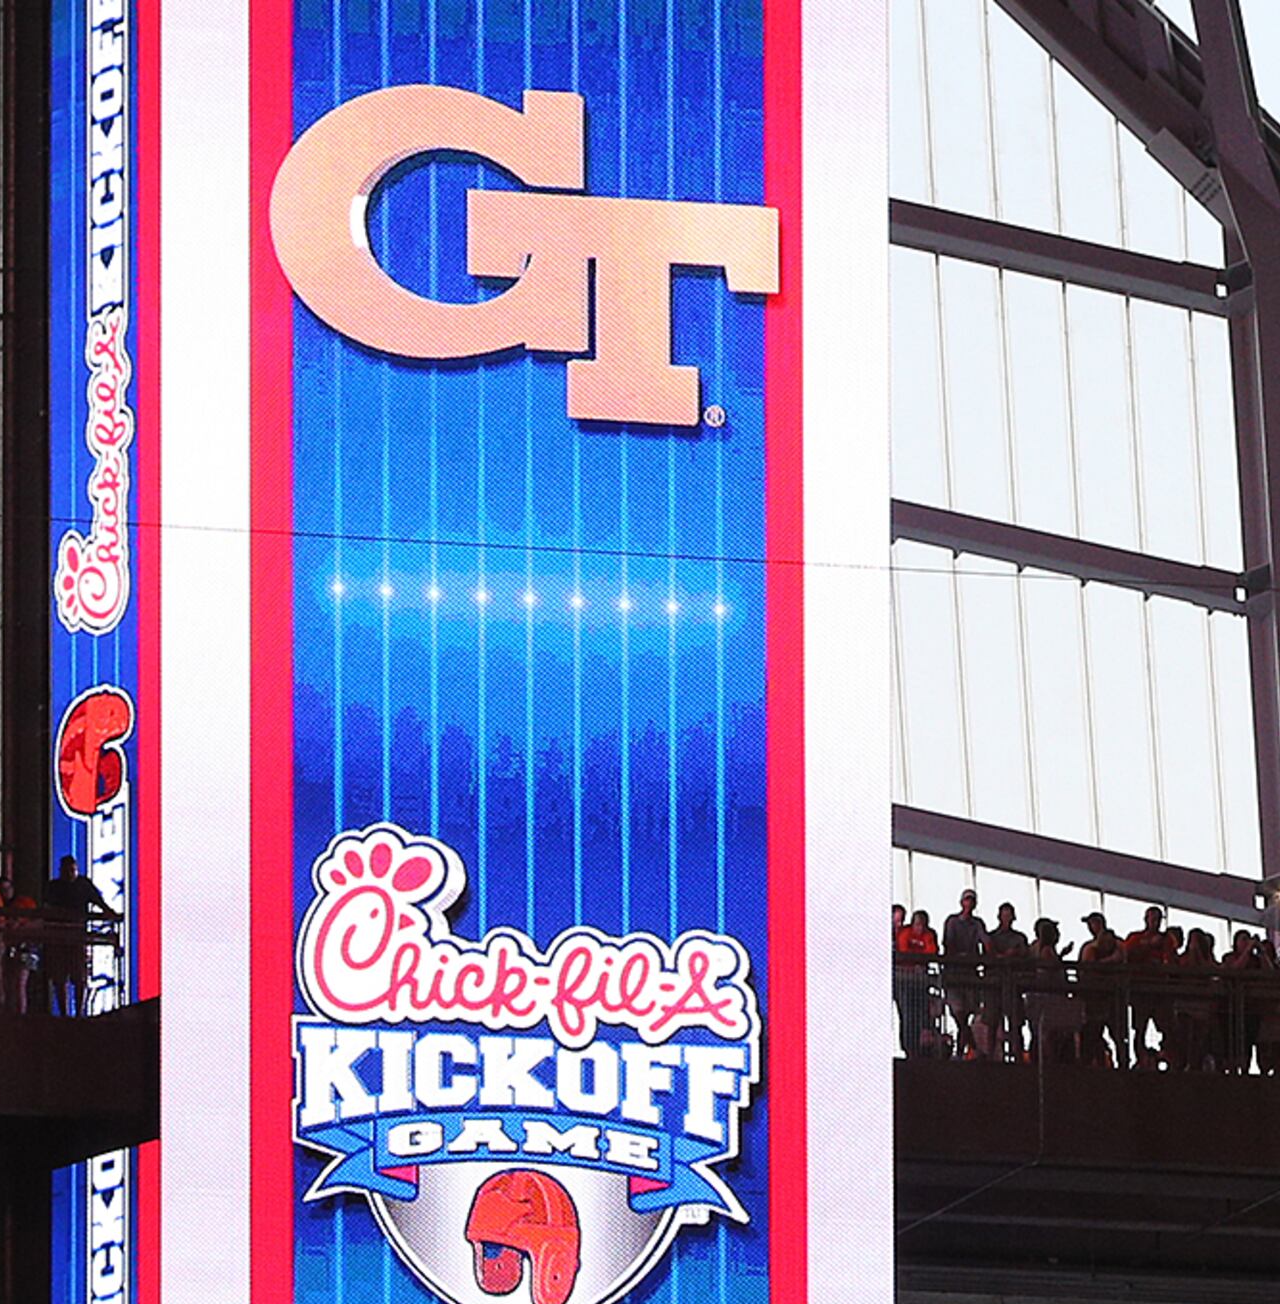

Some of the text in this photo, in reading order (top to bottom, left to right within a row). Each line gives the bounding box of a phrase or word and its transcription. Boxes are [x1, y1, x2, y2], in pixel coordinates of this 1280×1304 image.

[269, 83, 780, 426] GT
[76, 316, 125, 619] Chick-fil-A
[314, 885, 738, 1037] Chick-fil-A
[299, 1025, 751, 1145] KICKOFF
[386, 1118, 660, 1170] GAME
